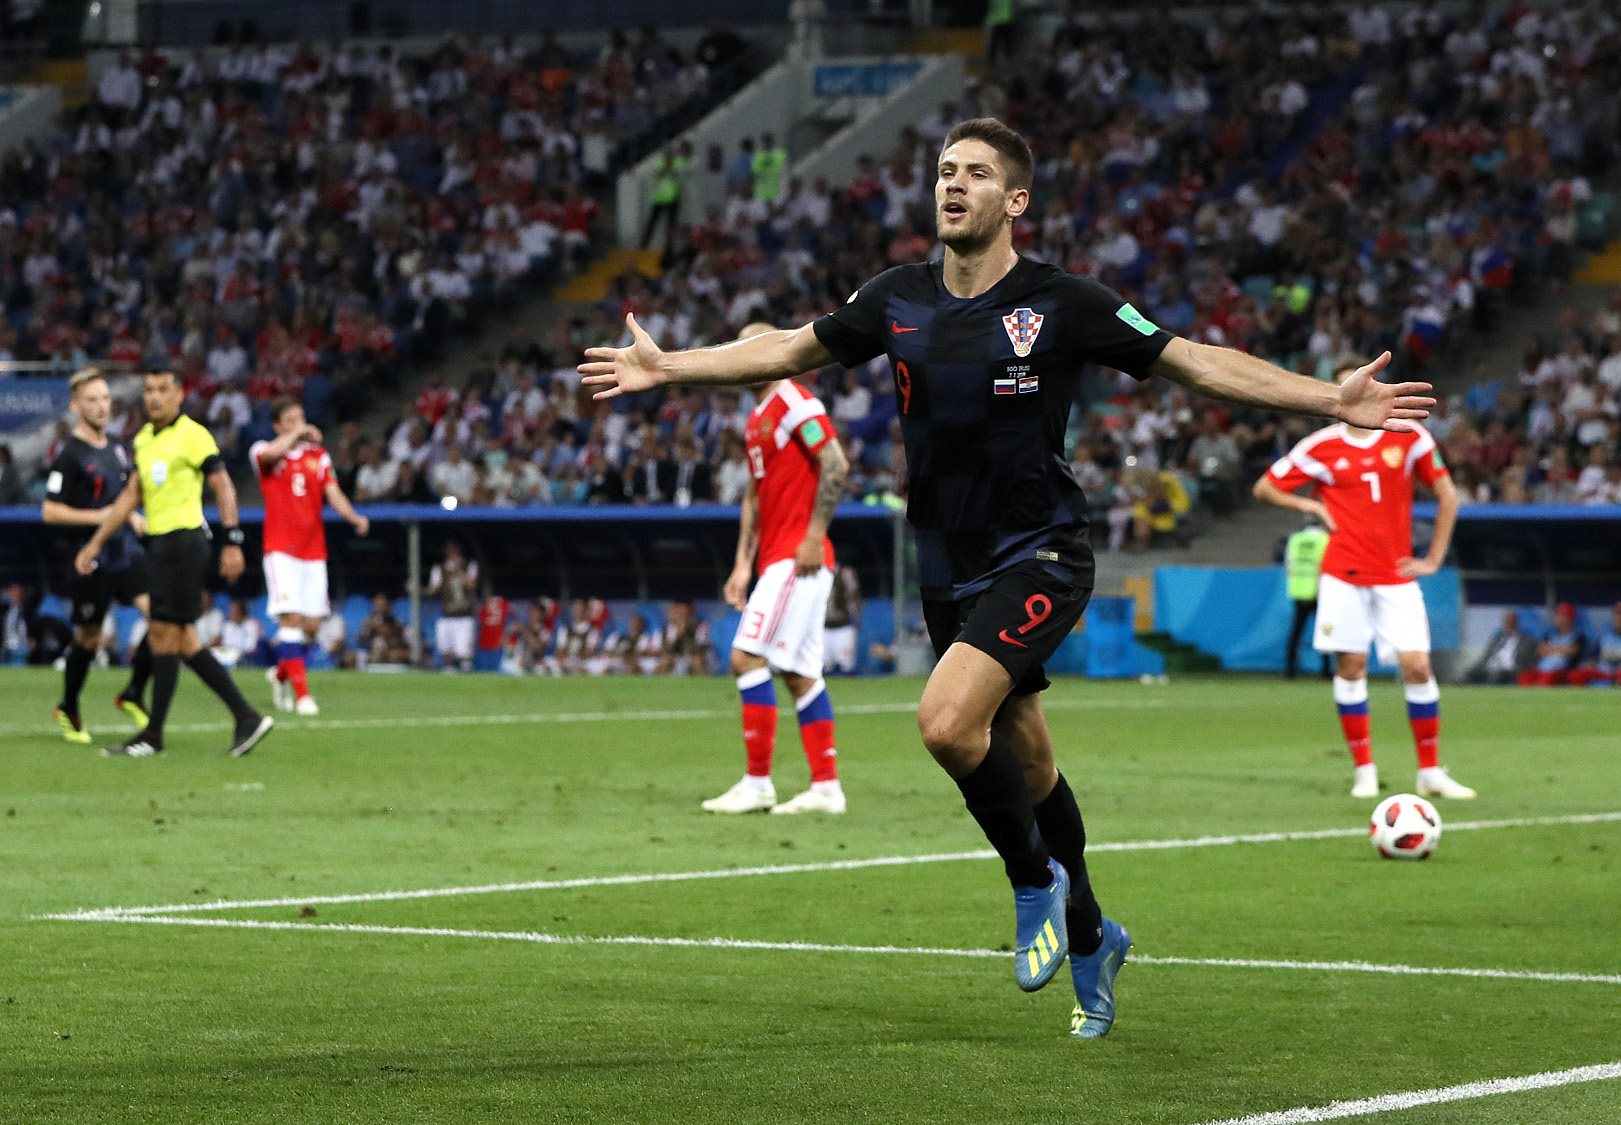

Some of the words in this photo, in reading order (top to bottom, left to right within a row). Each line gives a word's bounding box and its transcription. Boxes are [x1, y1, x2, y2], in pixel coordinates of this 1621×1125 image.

[896, 361, 911, 415] 9
[1360, 472, 1381, 503] 7
[1017, 594, 1053, 634] 9
